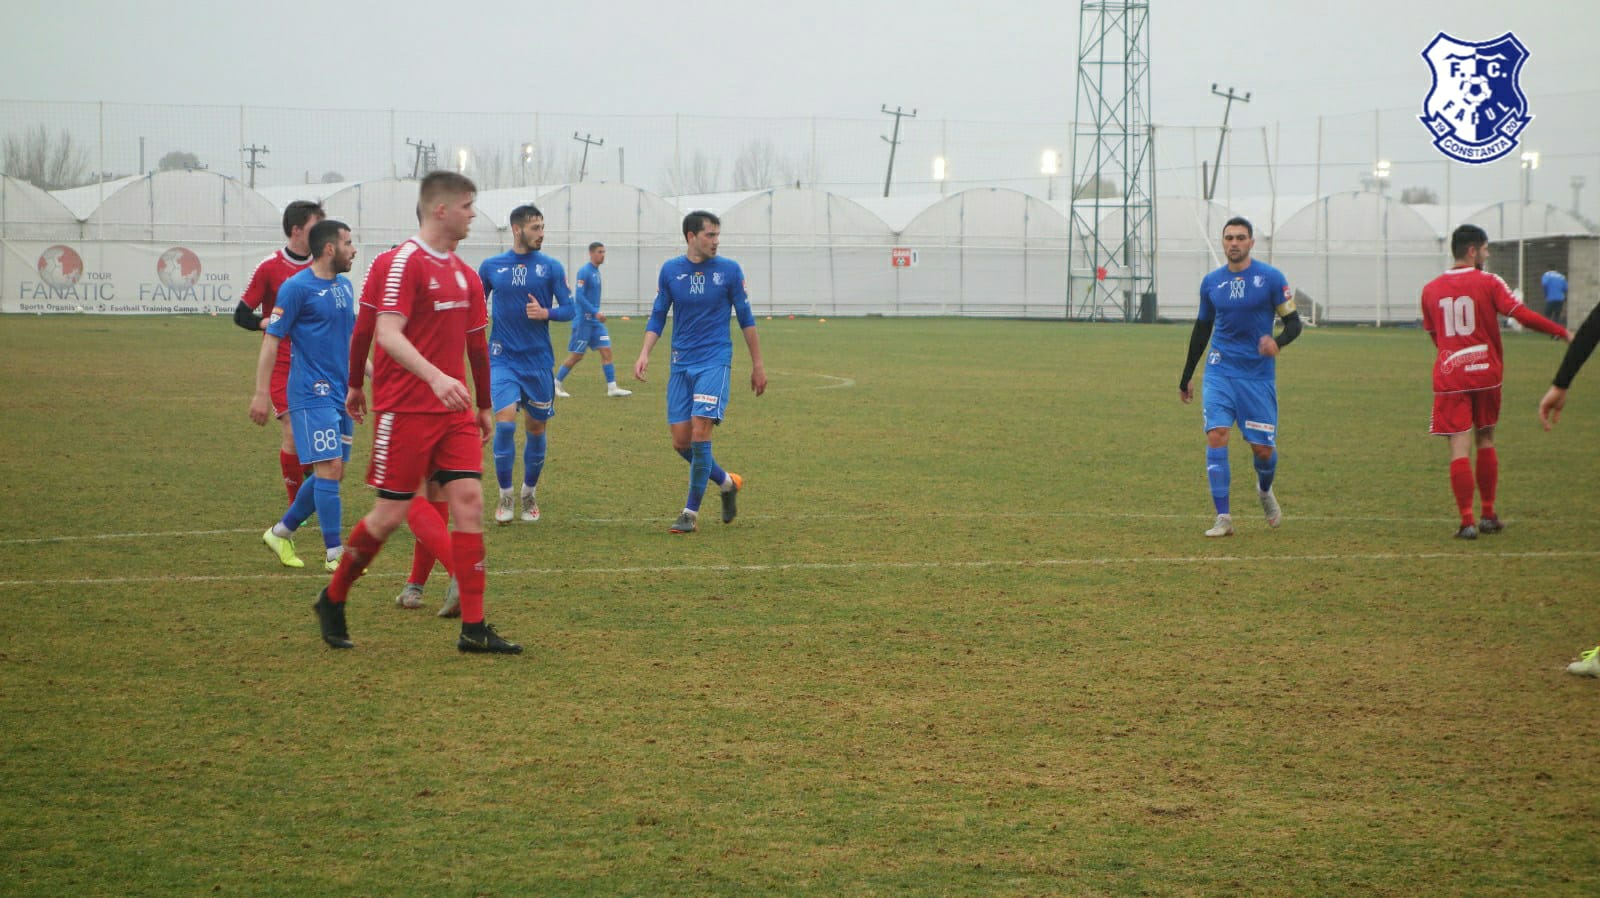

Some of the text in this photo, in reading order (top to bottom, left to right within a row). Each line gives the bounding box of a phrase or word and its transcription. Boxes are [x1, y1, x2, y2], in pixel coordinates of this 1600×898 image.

[86, 271, 112, 281] TOUR
[205, 272, 230, 282] TOUR
[511, 266, 528, 277] 100
[511, 276, 526, 286] ANI
[689, 274, 706, 285] 100
[1229, 279, 1246, 290] 100
[19, 281, 115, 301] FANATIC
[139, 282, 233, 302] FANATIC
[689, 284, 705, 295] ANI
[1229, 289, 1245, 300] ANI
[19, 303, 44, 312] Sports
[46, 303, 94, 312] Organision
[110, 304, 140, 313] Football
[142, 304, 172, 314] Training
[173, 305, 199, 314] Camps
[1438, 295, 1476, 337] 10
[313, 429, 338, 452] 88
